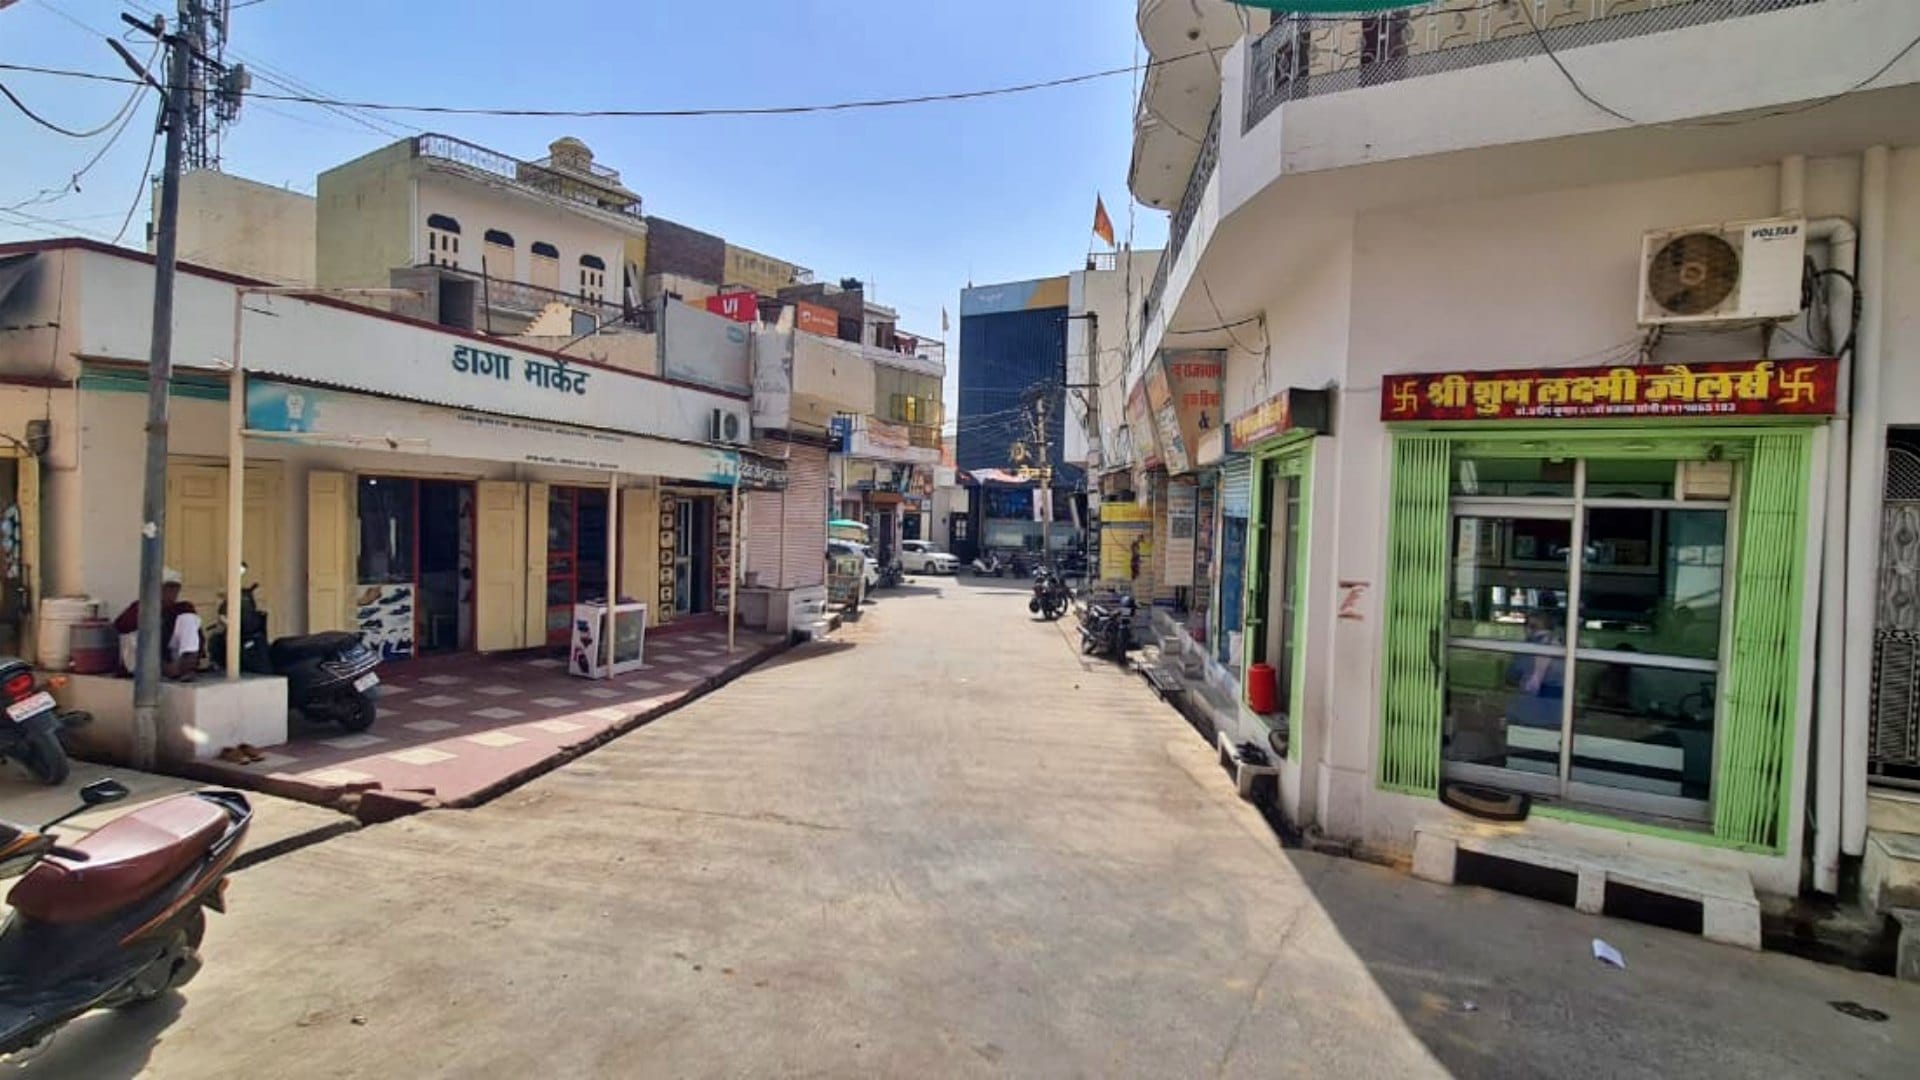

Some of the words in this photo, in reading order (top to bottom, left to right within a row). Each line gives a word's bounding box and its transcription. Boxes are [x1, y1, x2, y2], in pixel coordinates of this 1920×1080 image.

[452, 344, 512, 381] डागा
[1427, 373, 1467, 408] श्री
[1472, 378, 1531, 413] शुभ
[1537, 368, 1638, 405] लक्ष्मी
